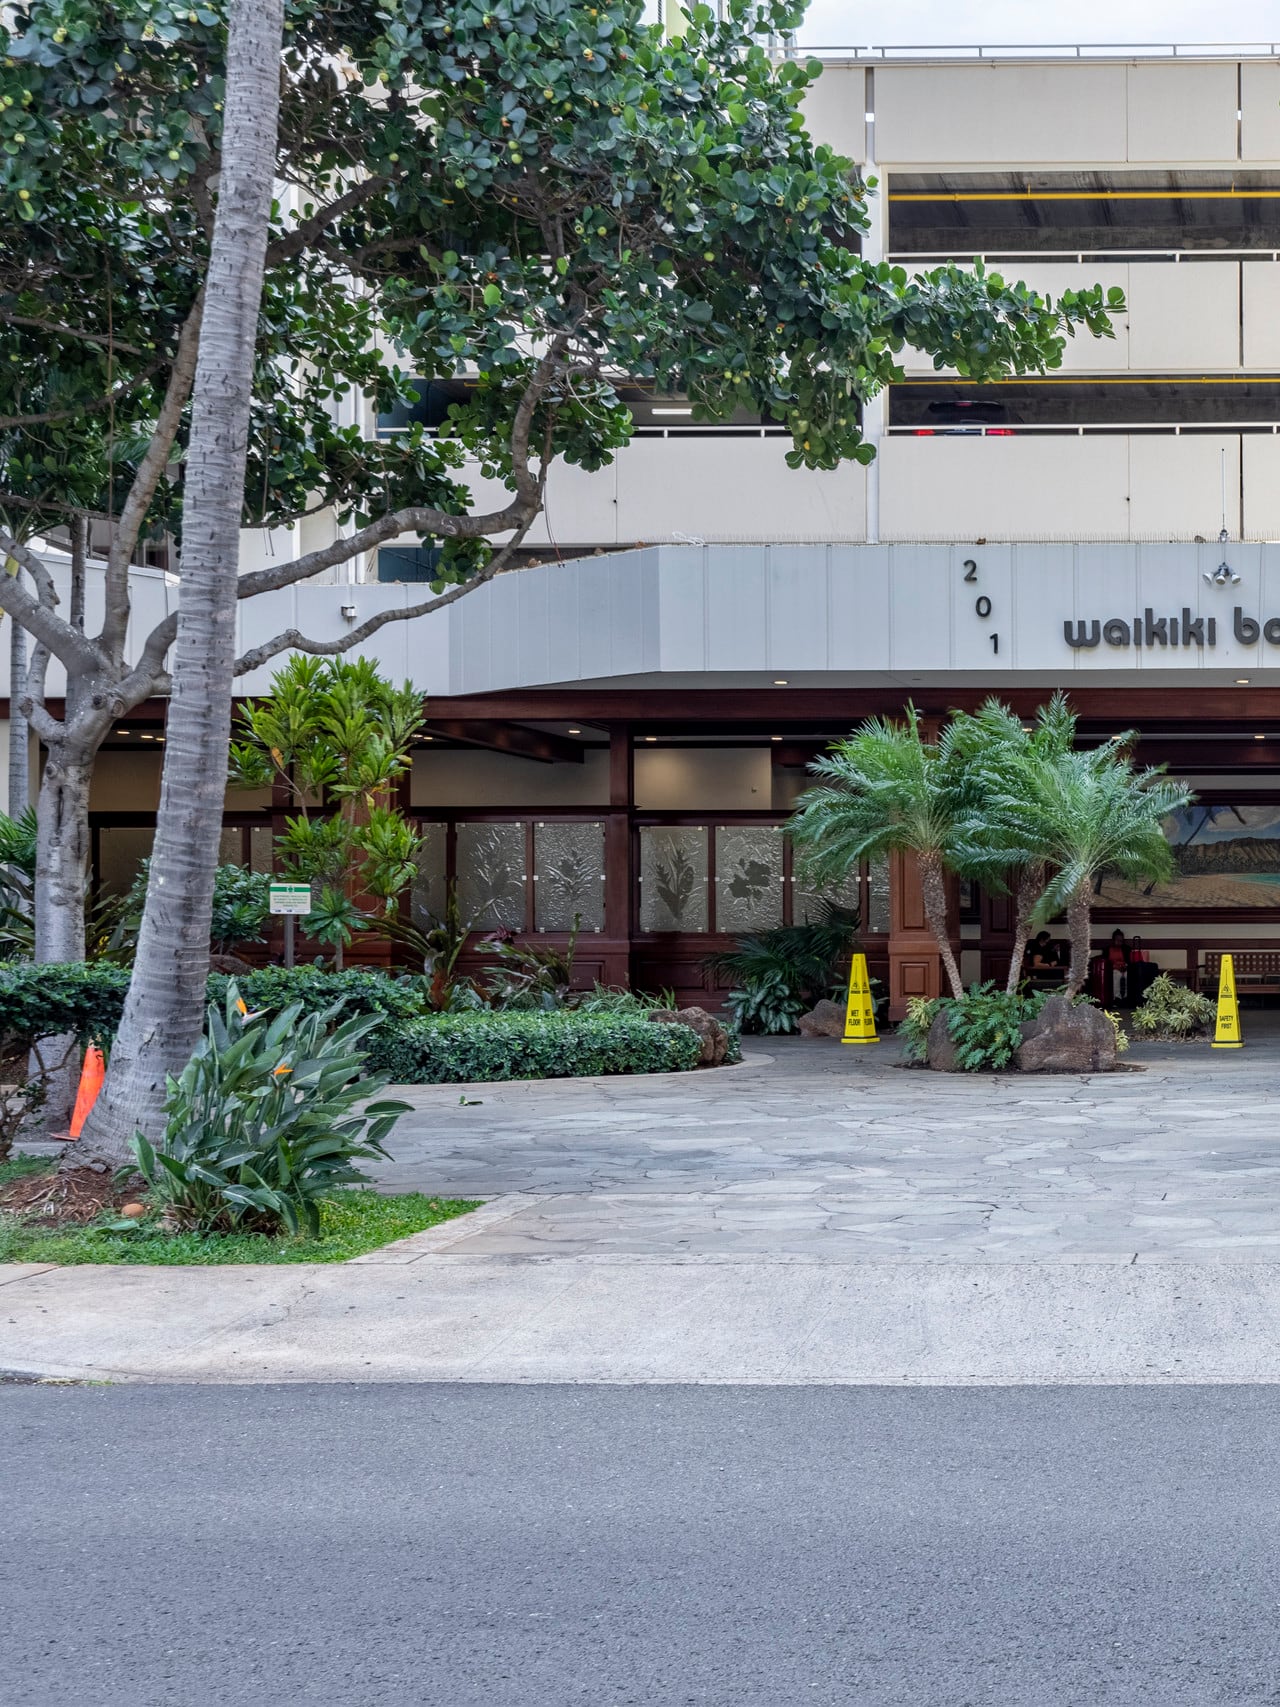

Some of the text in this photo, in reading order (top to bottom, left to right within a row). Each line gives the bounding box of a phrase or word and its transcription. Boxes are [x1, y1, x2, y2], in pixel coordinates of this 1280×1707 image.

[1063, 607, 1216, 648] waikiki
[851, 1009, 859, 1017] WET
[848, 1018, 861, 1026] FLOOR
